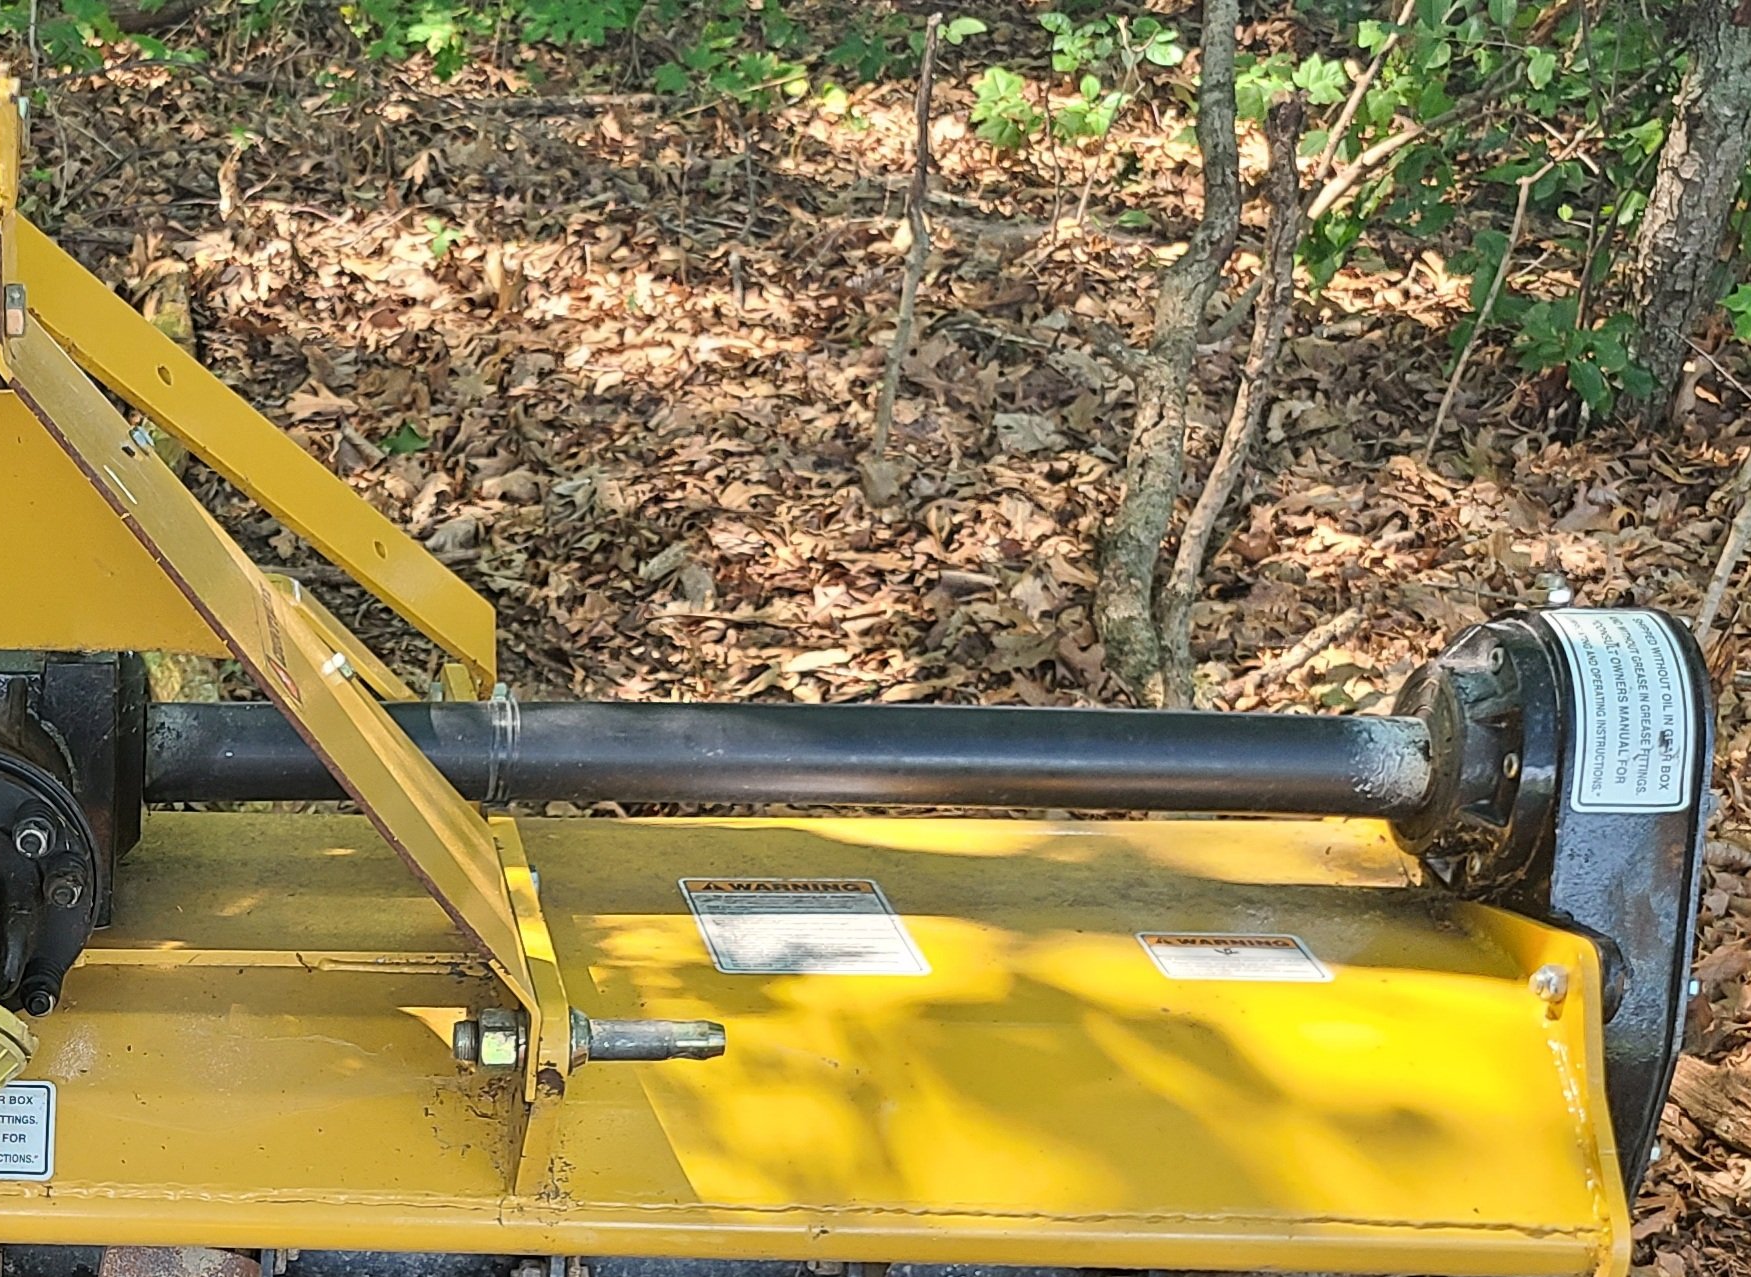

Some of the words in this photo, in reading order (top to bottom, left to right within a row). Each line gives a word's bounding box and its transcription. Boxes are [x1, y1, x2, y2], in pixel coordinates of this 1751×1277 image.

[1586, 650, 1598, 668] AND
[1652, 647, 1671, 691] WITHOUT
[1610, 657, 1629, 703] OWNERS
[1631, 655, 1649, 692] GREASE
[1590, 667, 1607, 717] OPERATING
[1639, 692, 1650, 703] IN
[1661, 693, 1673, 712] OIL
[1617, 705, 1630, 756] MANUAL
[1639, 704, 1652, 745] GREASE
[1663, 714, 1674, 726] IN
[1615, 759, 1628, 784] FOR
[1658, 765, 1672, 791] BOX
[727, 882, 862, 892] WARNING
[1177, 937, 1291, 948] WARNING
[9, 1095, 34, 1105] BOX
[2, 1133, 27, 1143] FOR
